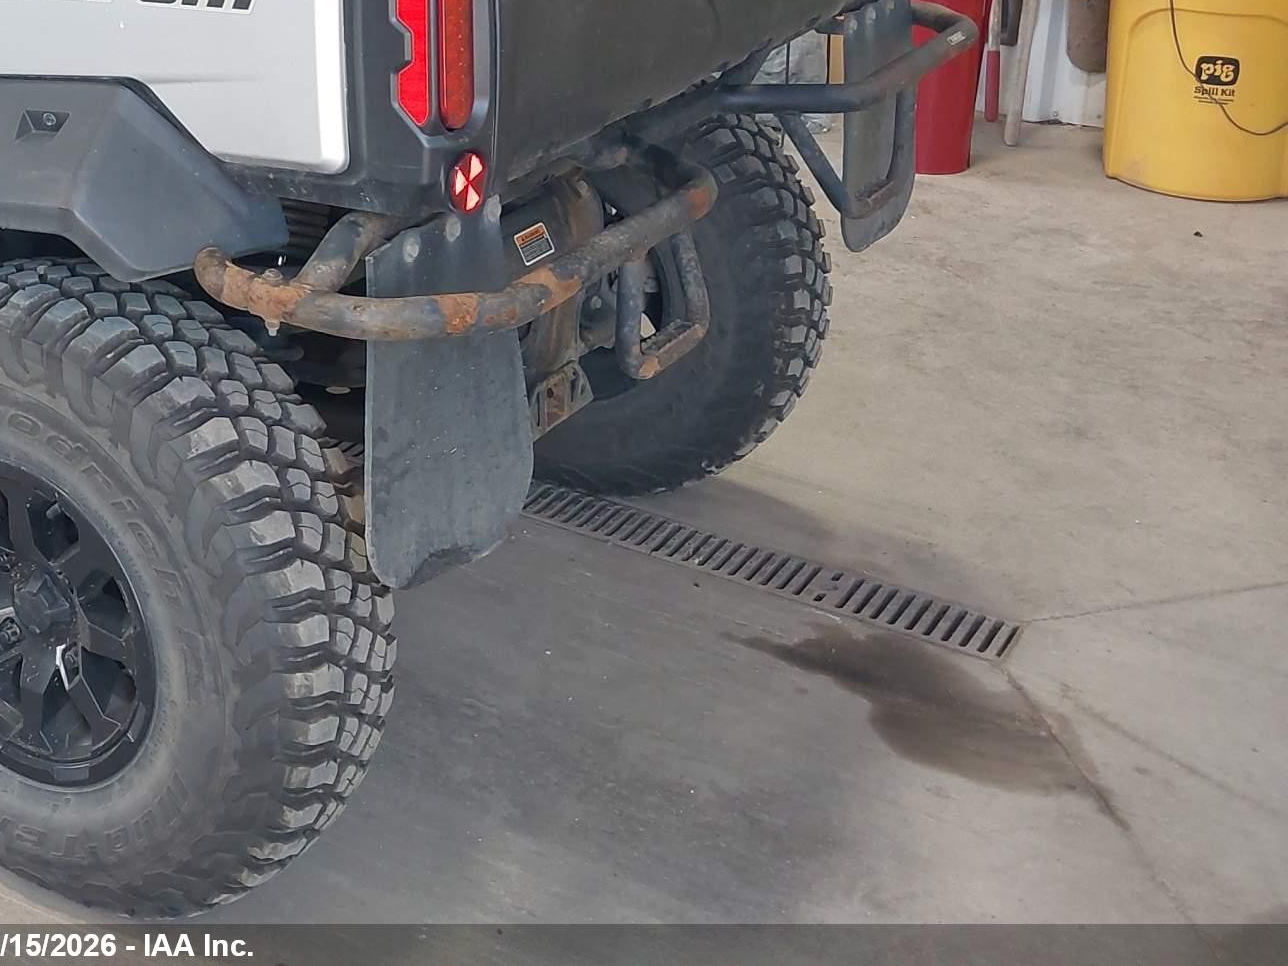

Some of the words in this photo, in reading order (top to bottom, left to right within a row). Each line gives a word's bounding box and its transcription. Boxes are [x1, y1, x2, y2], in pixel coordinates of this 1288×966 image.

[1200, 60, 1235, 82] pig
[1194, 85, 1218, 96] Spill
[1221, 88, 1235, 97] Kit
